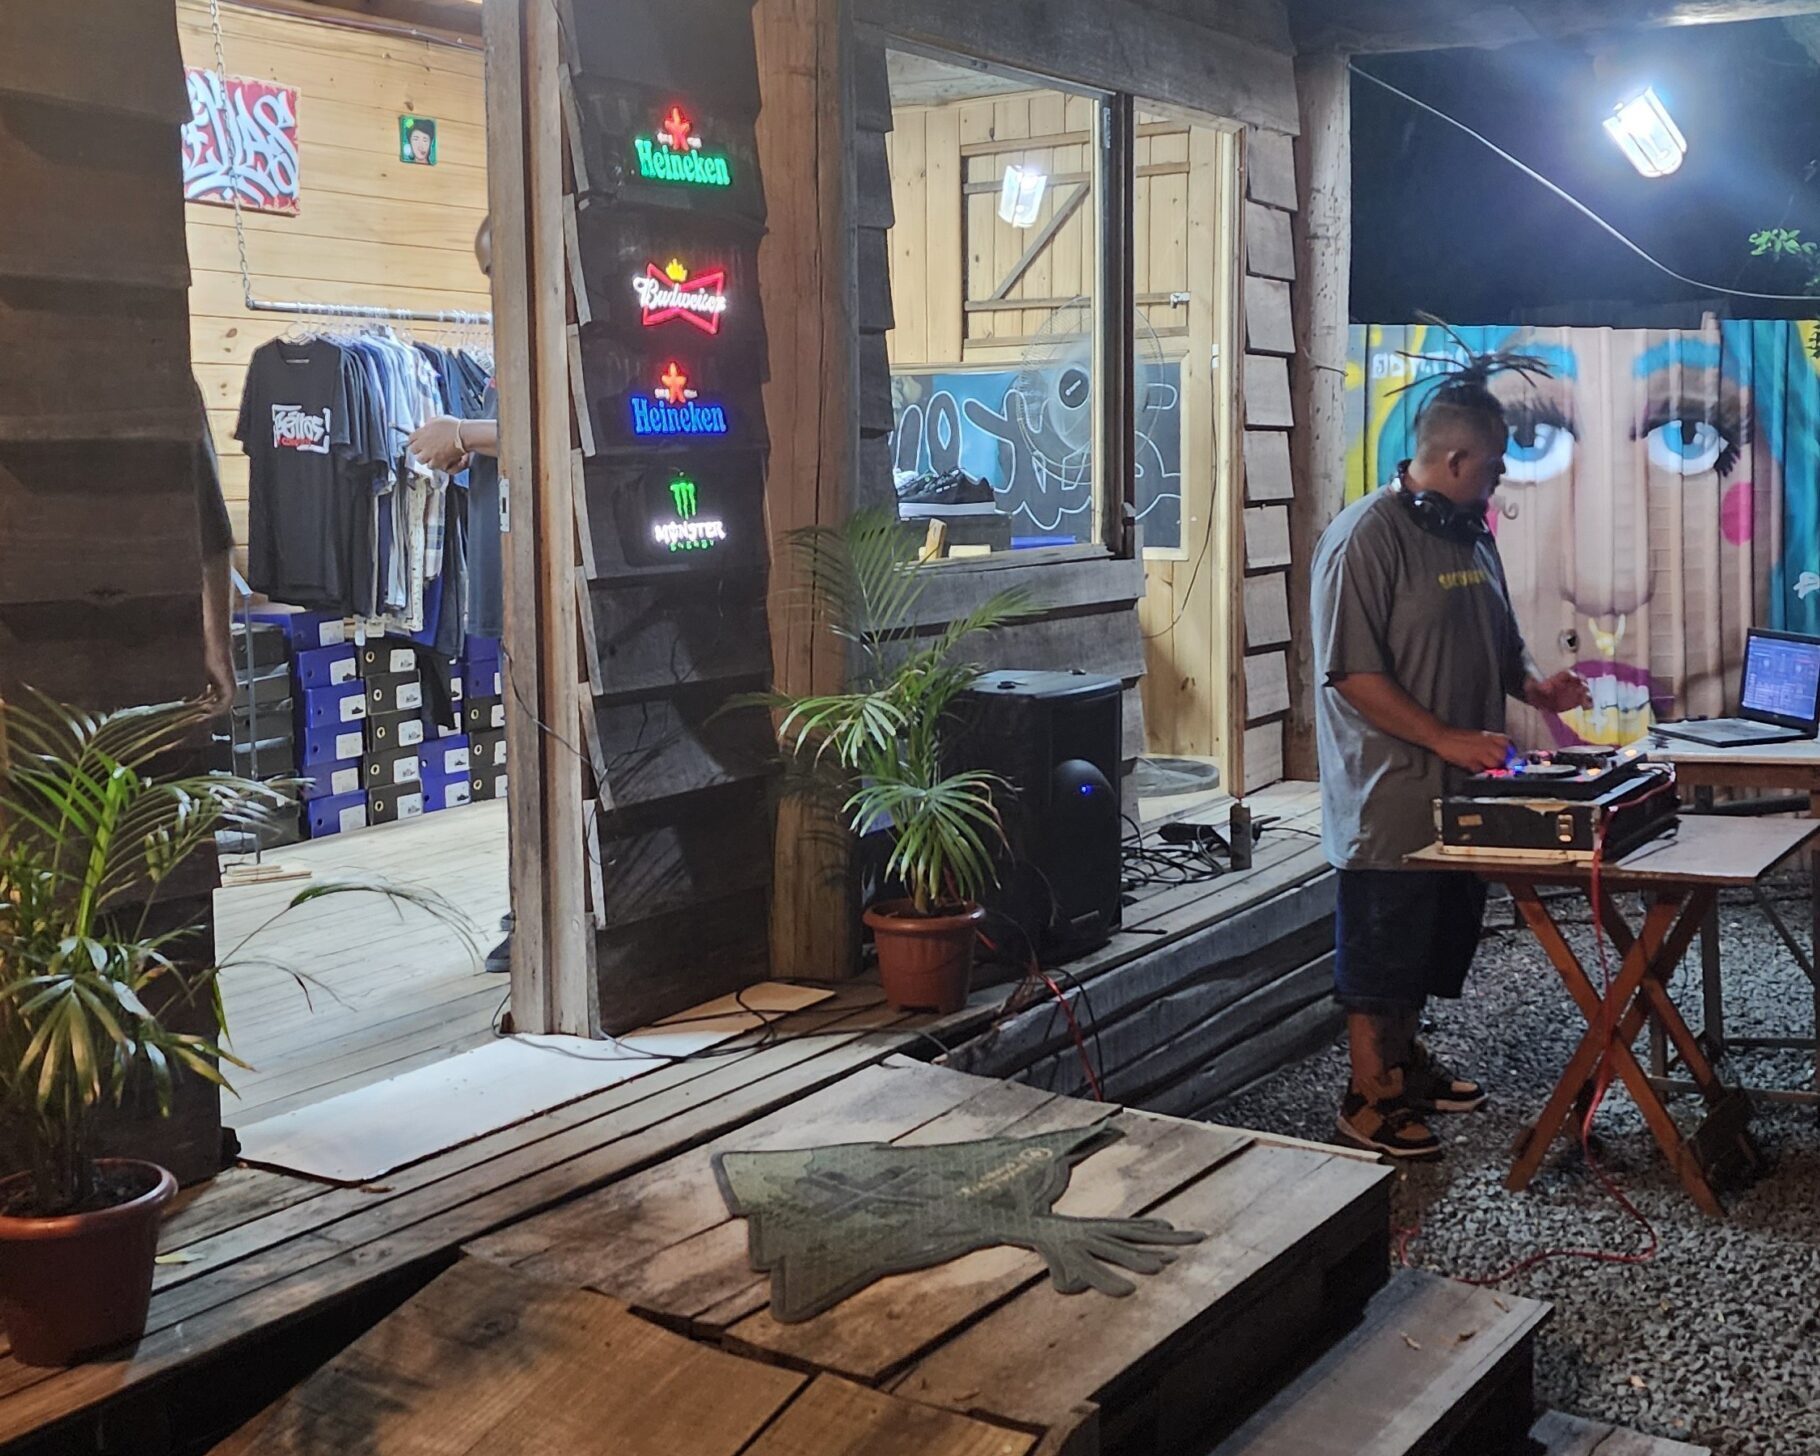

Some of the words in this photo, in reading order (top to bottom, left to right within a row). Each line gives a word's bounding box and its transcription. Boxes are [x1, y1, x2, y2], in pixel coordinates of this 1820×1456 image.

[634, 138, 731, 185] Heineken
[632, 276, 727, 313] Budweiser
[631, 397, 727, 433] Heineken
[654, 520, 727, 545] MONSTER
